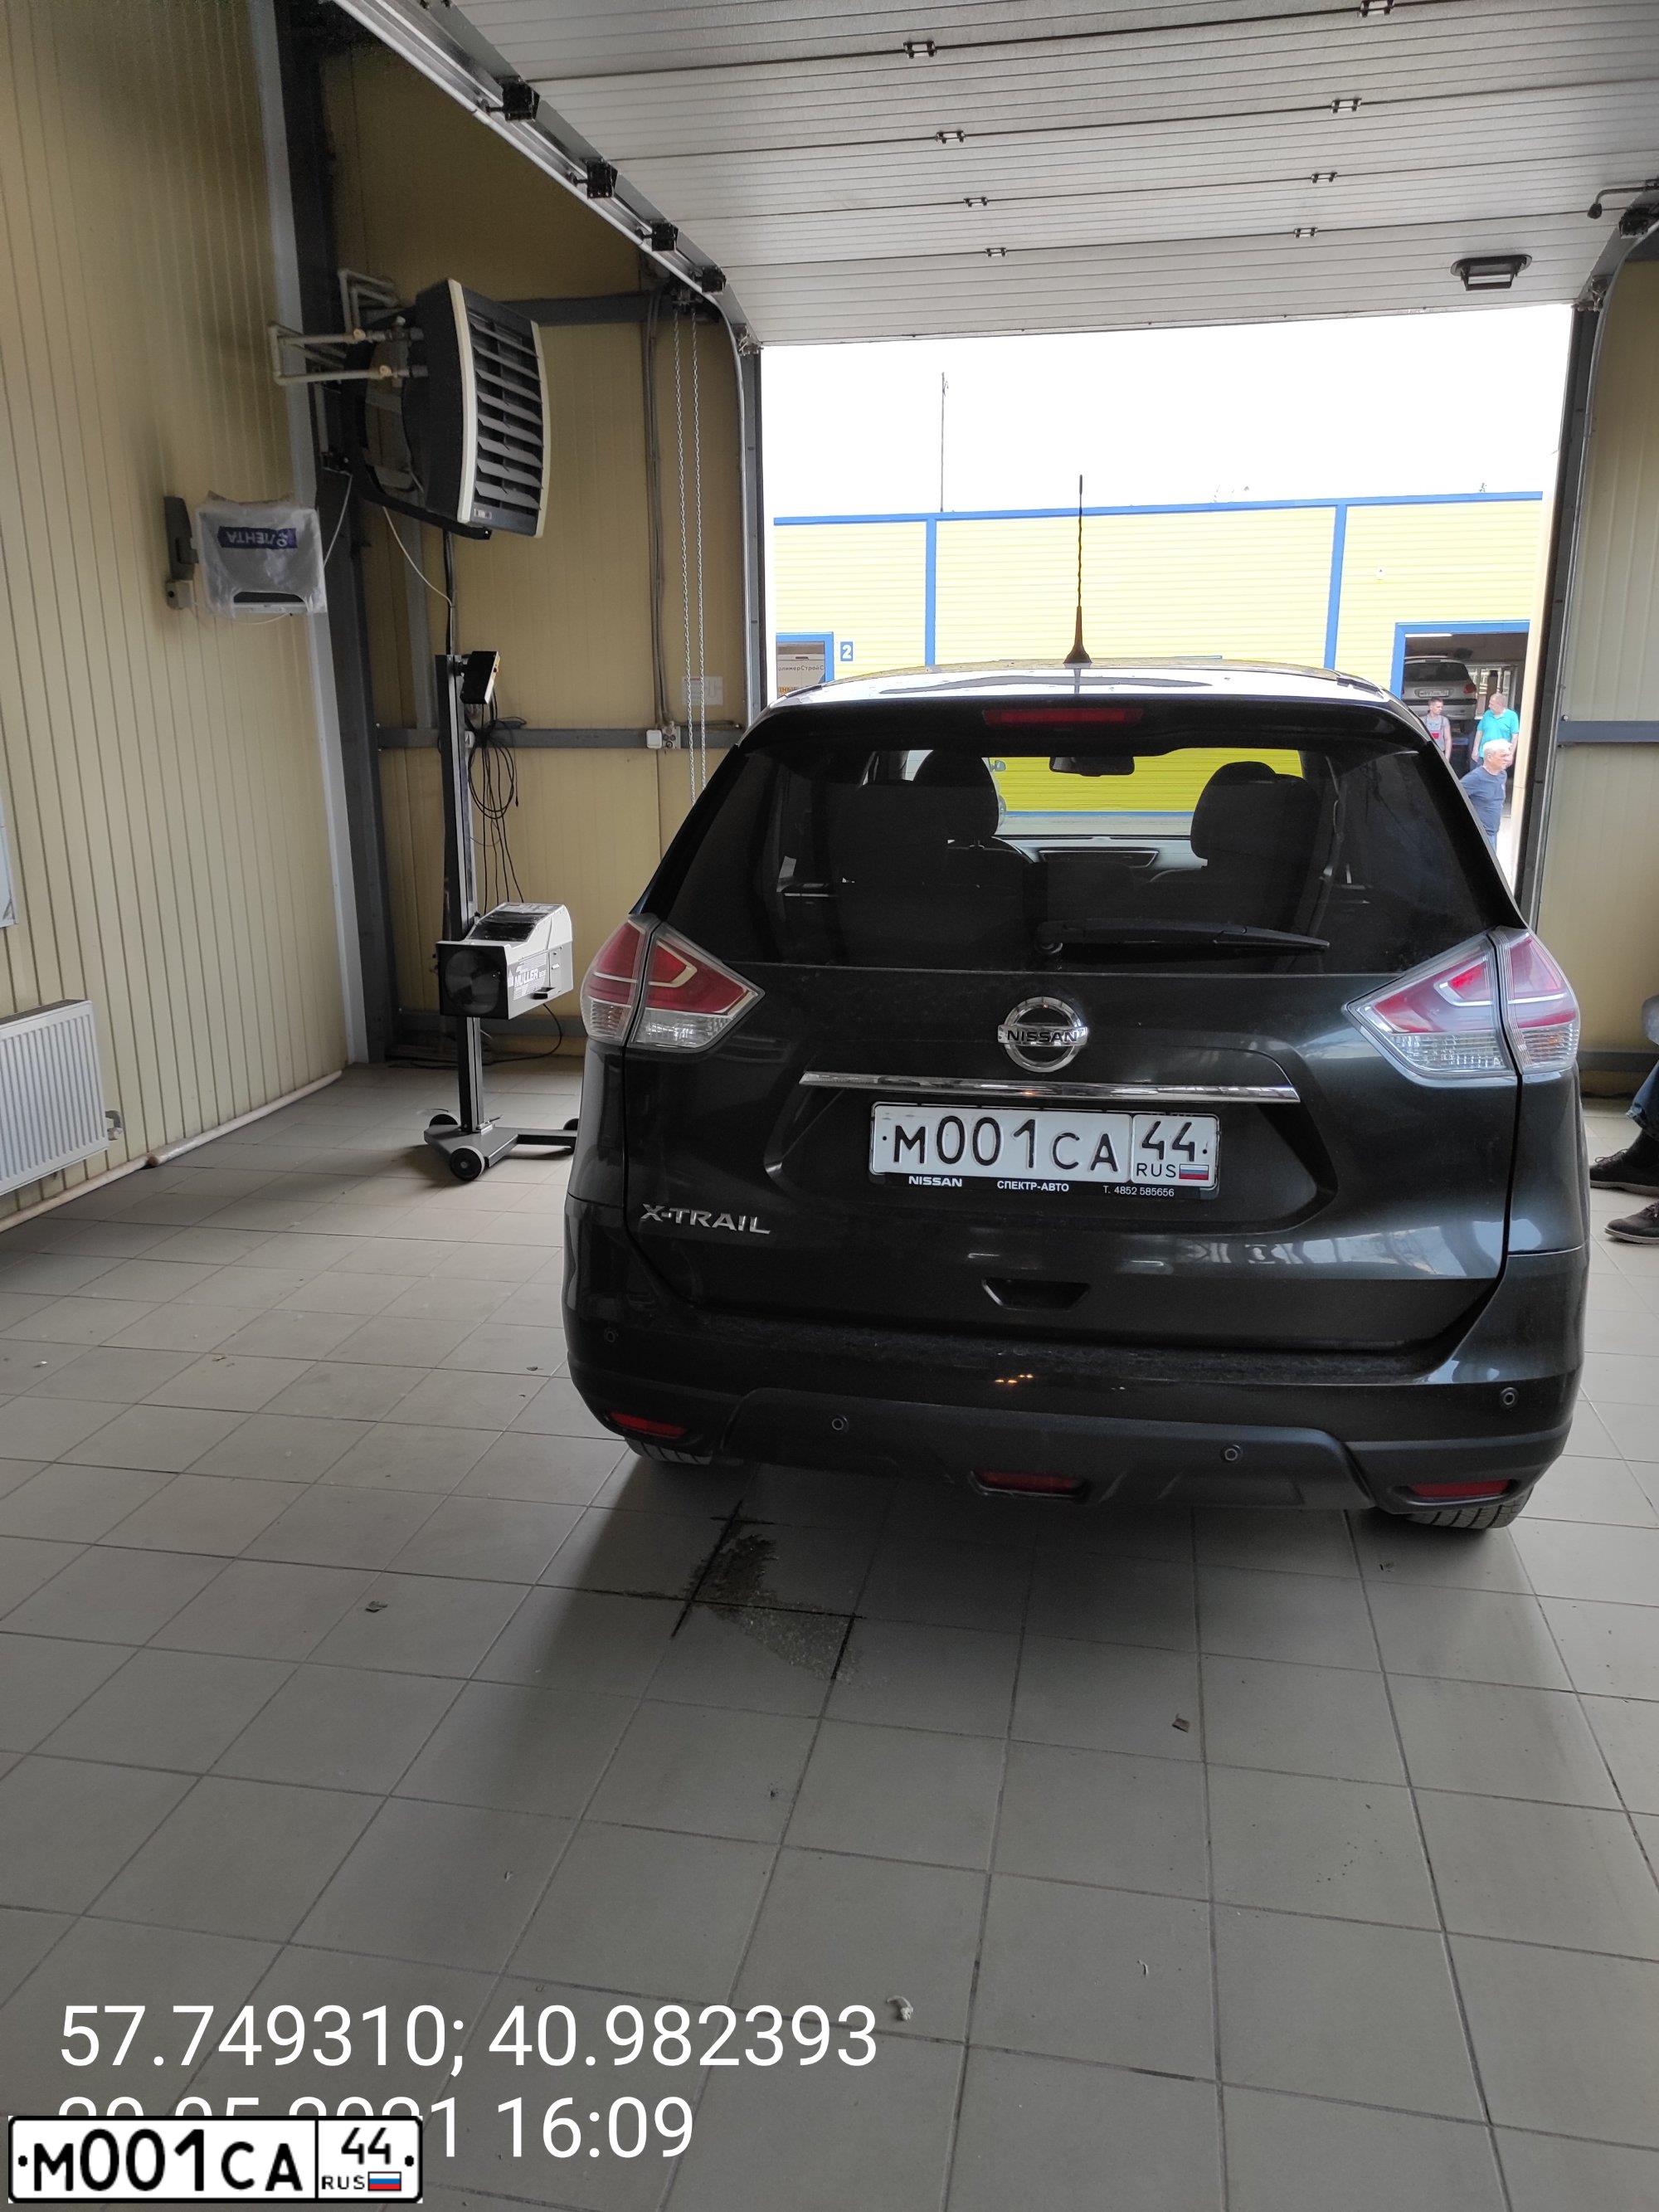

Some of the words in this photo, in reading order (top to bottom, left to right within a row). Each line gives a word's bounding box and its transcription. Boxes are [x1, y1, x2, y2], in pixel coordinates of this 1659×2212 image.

[226, 530, 275, 545] ЛЕНТА
[842, 644, 852, 660] 2
[1007, 1030, 1078, 1042] NISSAN
[1141, 1120, 1195, 1162] 44
[1136, 1162, 1176, 1178] RUS
[908, 1176, 963, 1187] NISSAN
[996, 1180, 1070, 1192] СПЕКТР-АВТО
[1102, 1186, 1112, 1194] Т.
[1114, 1186, 1137, 1196] 4852
[1140, 1186, 1175, 1197] 585656
[640, 1203, 771, 1235] X-TRAIL
